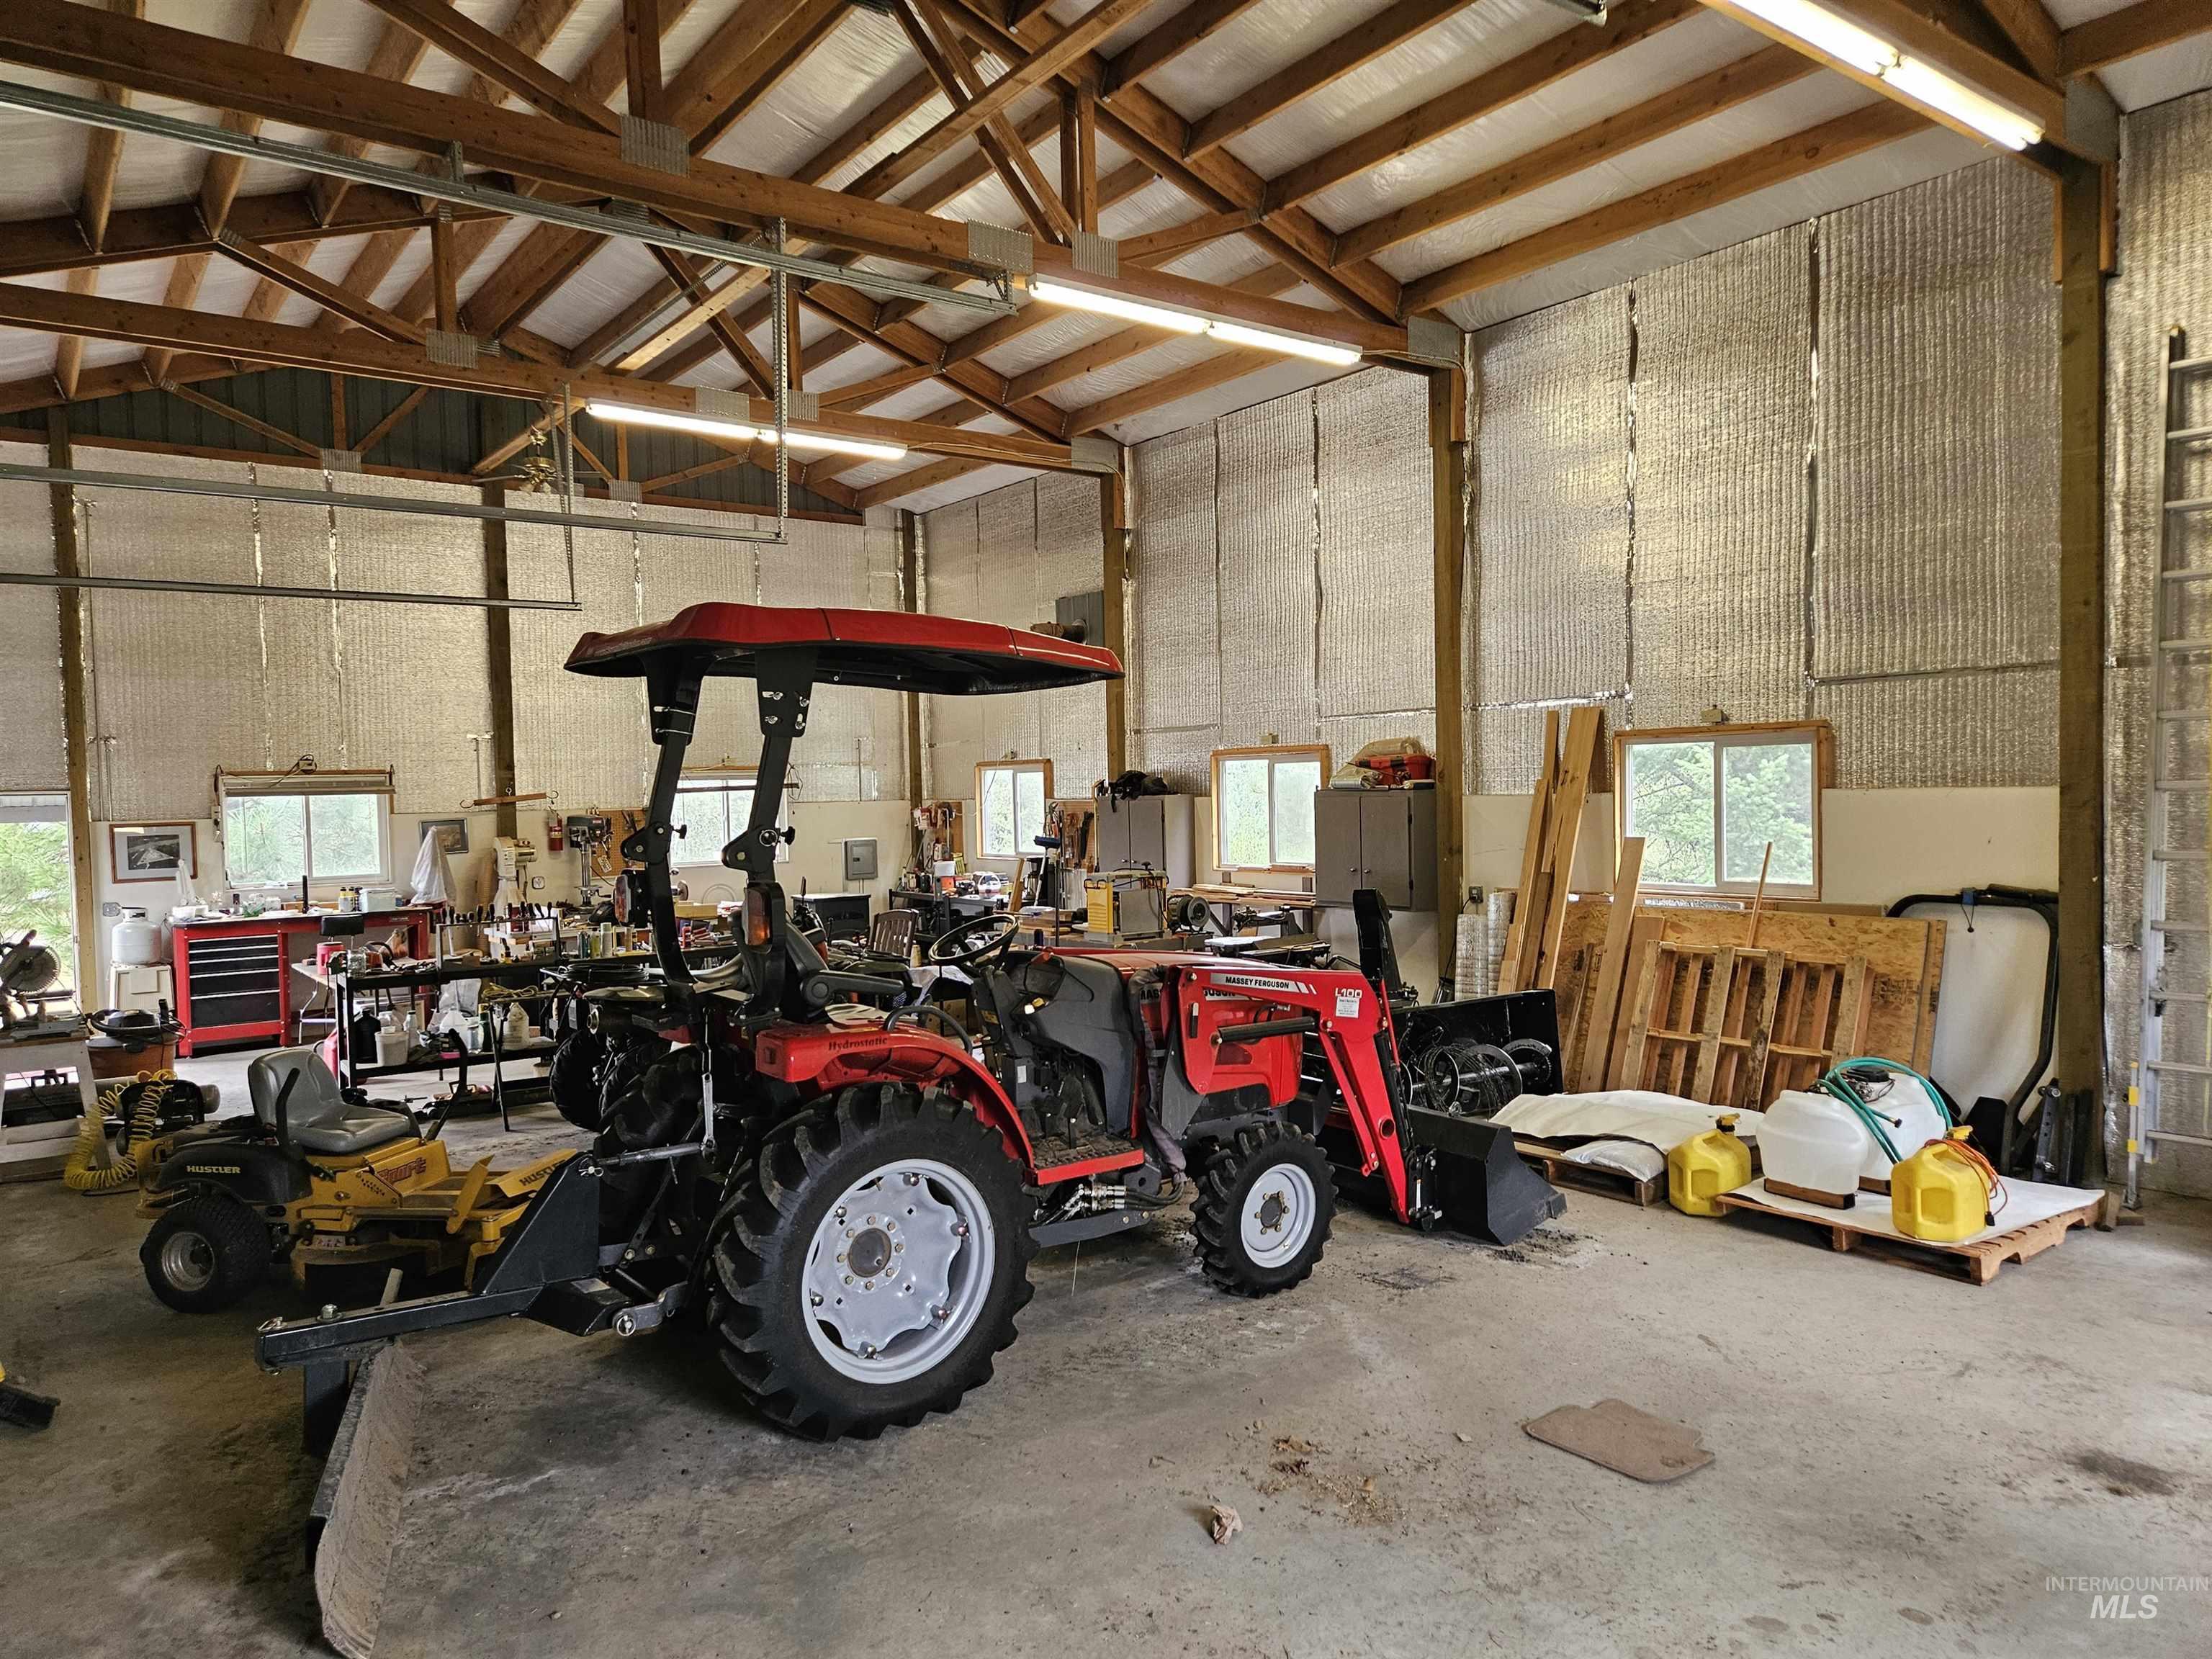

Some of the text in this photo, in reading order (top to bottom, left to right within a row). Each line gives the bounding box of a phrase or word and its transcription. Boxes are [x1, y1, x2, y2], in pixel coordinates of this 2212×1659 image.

[1226, 976, 1290, 989] MASSEY FERGUSON
[829, 1037, 888, 1051] Hydrostatic
[186, 1165, 241, 1174] HUSTLER
